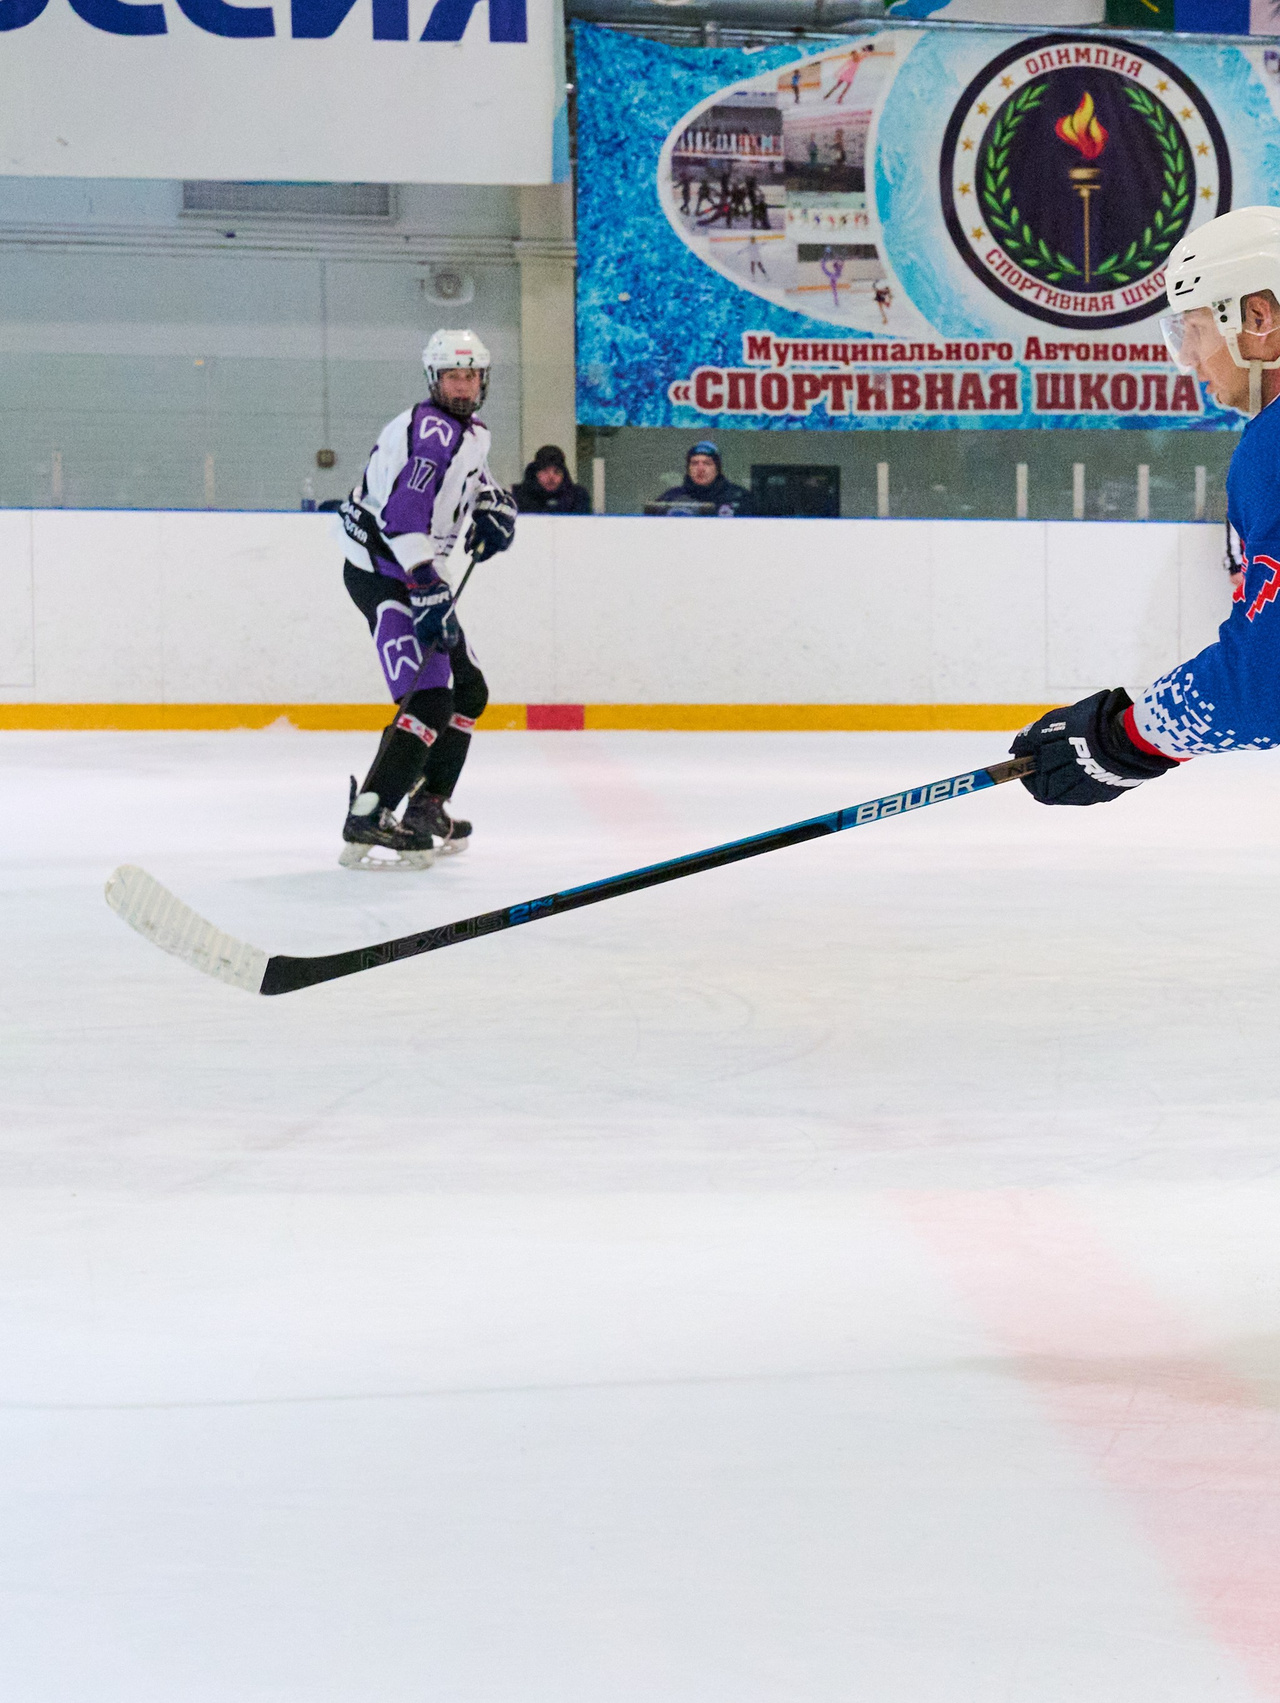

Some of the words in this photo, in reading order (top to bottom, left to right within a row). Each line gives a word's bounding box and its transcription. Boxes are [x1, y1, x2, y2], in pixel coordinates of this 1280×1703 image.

[1025, 47, 1143, 78] ОЛИМПИЯ
[985, 248, 1116, 313] СПОРТИВНАЯ
[1121, 265, 1168, 306] ШКО
[746, 335, 1013, 367] Муниципального
[673, 371, 1018, 411] «СПОРТИВНАЯ
[1035, 373, 1200, 411] ШКОЛА
[407, 456, 438, 494] 17
[855, 774, 976, 825] BAUER
[360, 913, 503, 969] NEXUS
